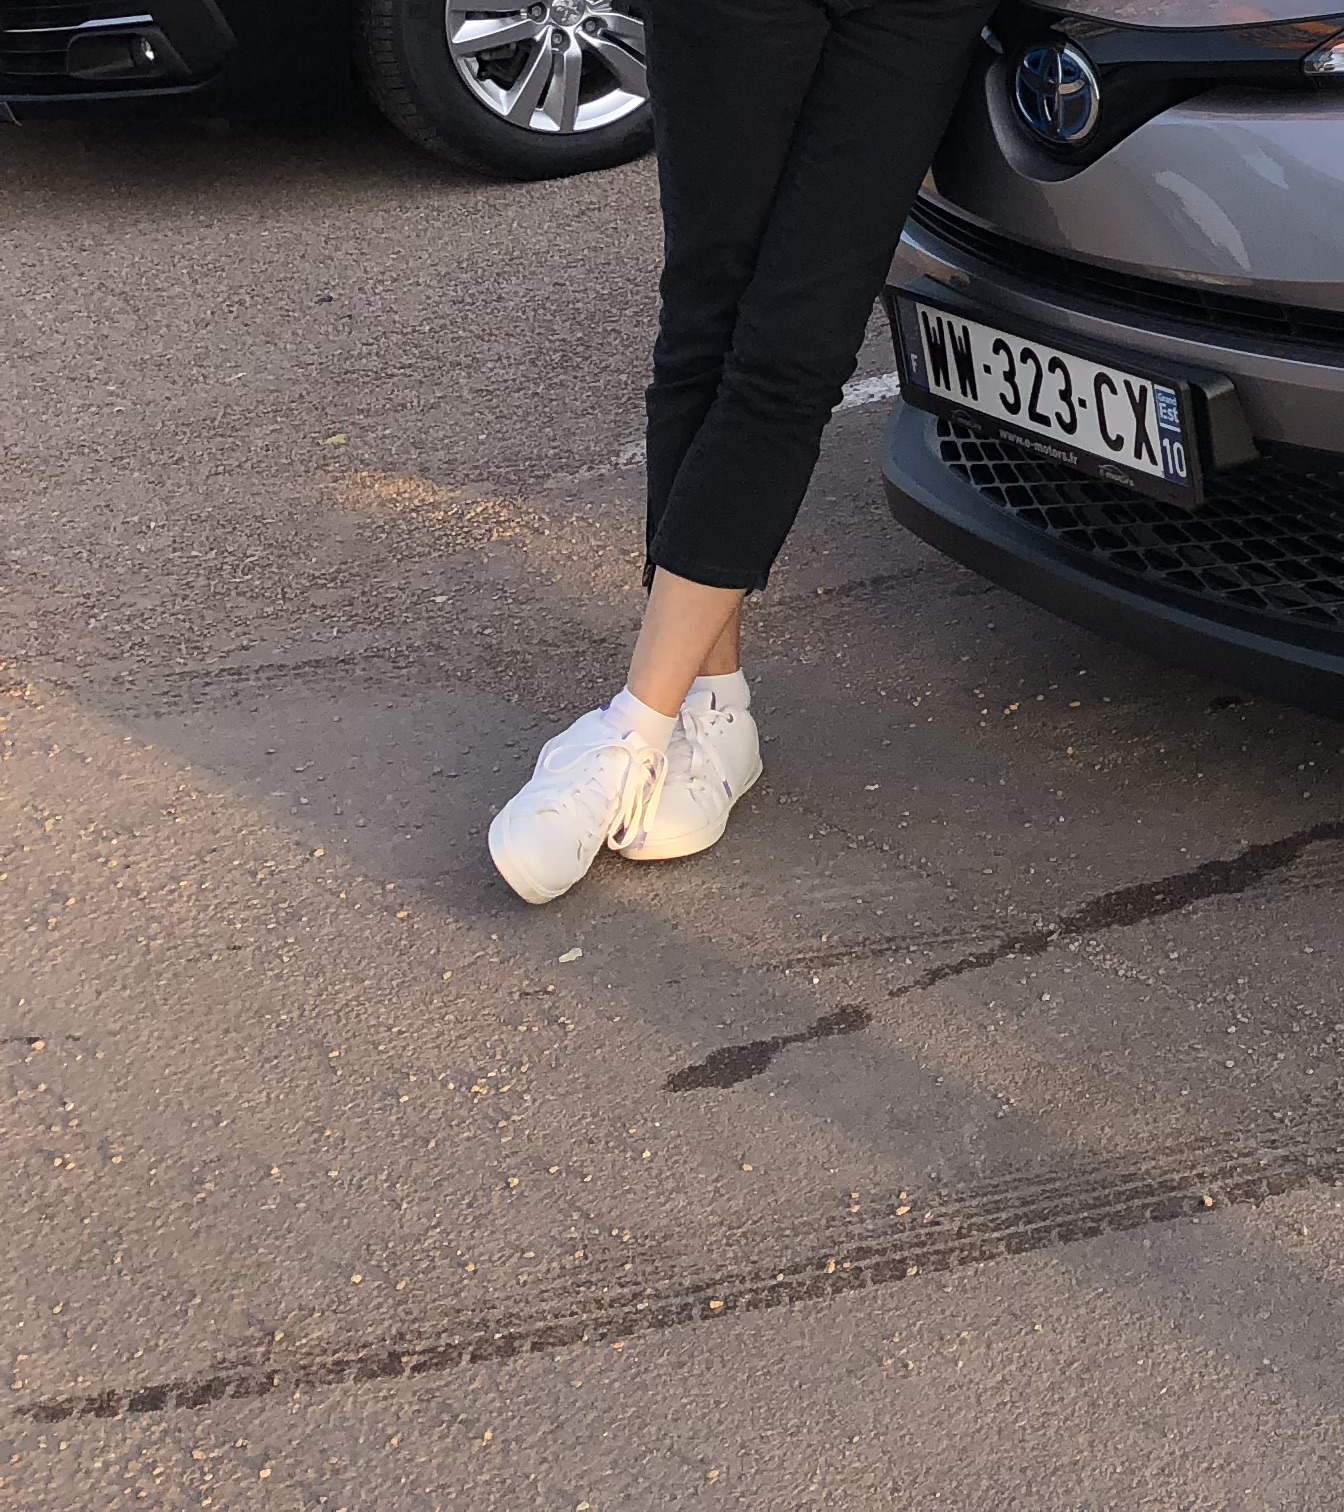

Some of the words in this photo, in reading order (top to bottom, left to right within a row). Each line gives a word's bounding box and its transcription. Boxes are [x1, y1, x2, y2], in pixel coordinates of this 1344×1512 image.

[921, 310, 1158, 466] WW-323-CX
[1159, 402, 1179, 423] Est
[1162, 437, 1187, 478] 10
